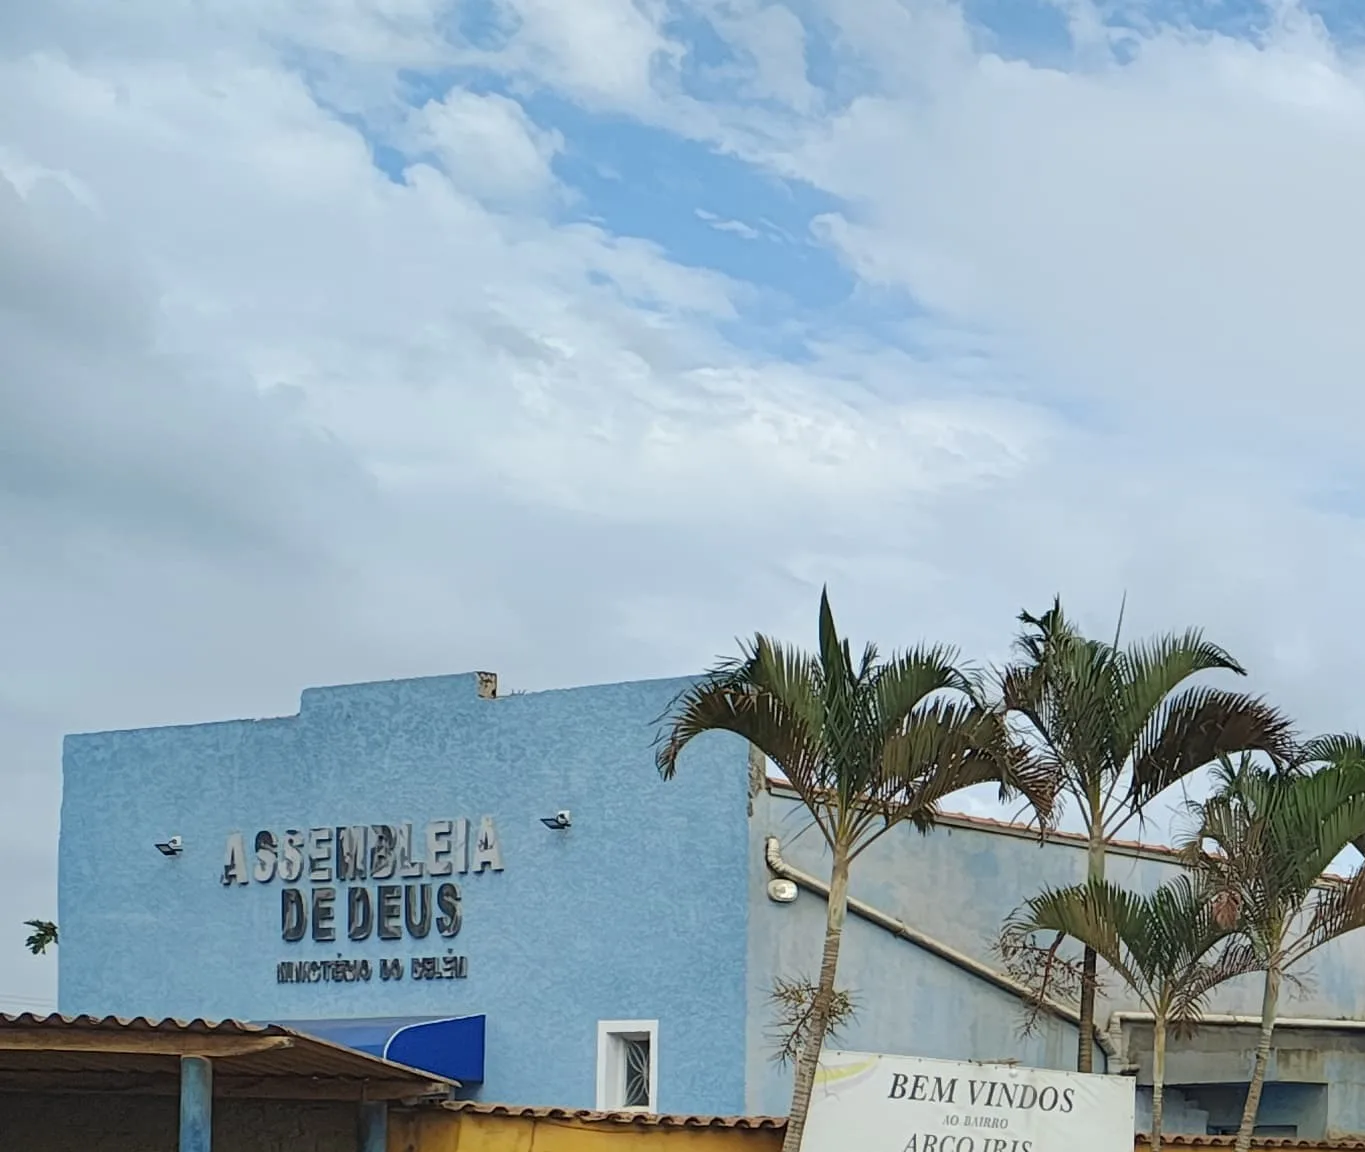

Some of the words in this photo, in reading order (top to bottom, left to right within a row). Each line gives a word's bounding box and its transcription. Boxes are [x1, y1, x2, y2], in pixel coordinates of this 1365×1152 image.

[220, 816, 504, 886] ASSEMBLEIA
[282, 887, 336, 942] DE
[348, 883, 463, 941] DEUS
[888, 1073, 958, 1103] BEM
[968, 1080, 1075, 1113] VINDOS
[942, 1115, 960, 1126] AO
[964, 1116, 1009, 1129] BAIRRO
